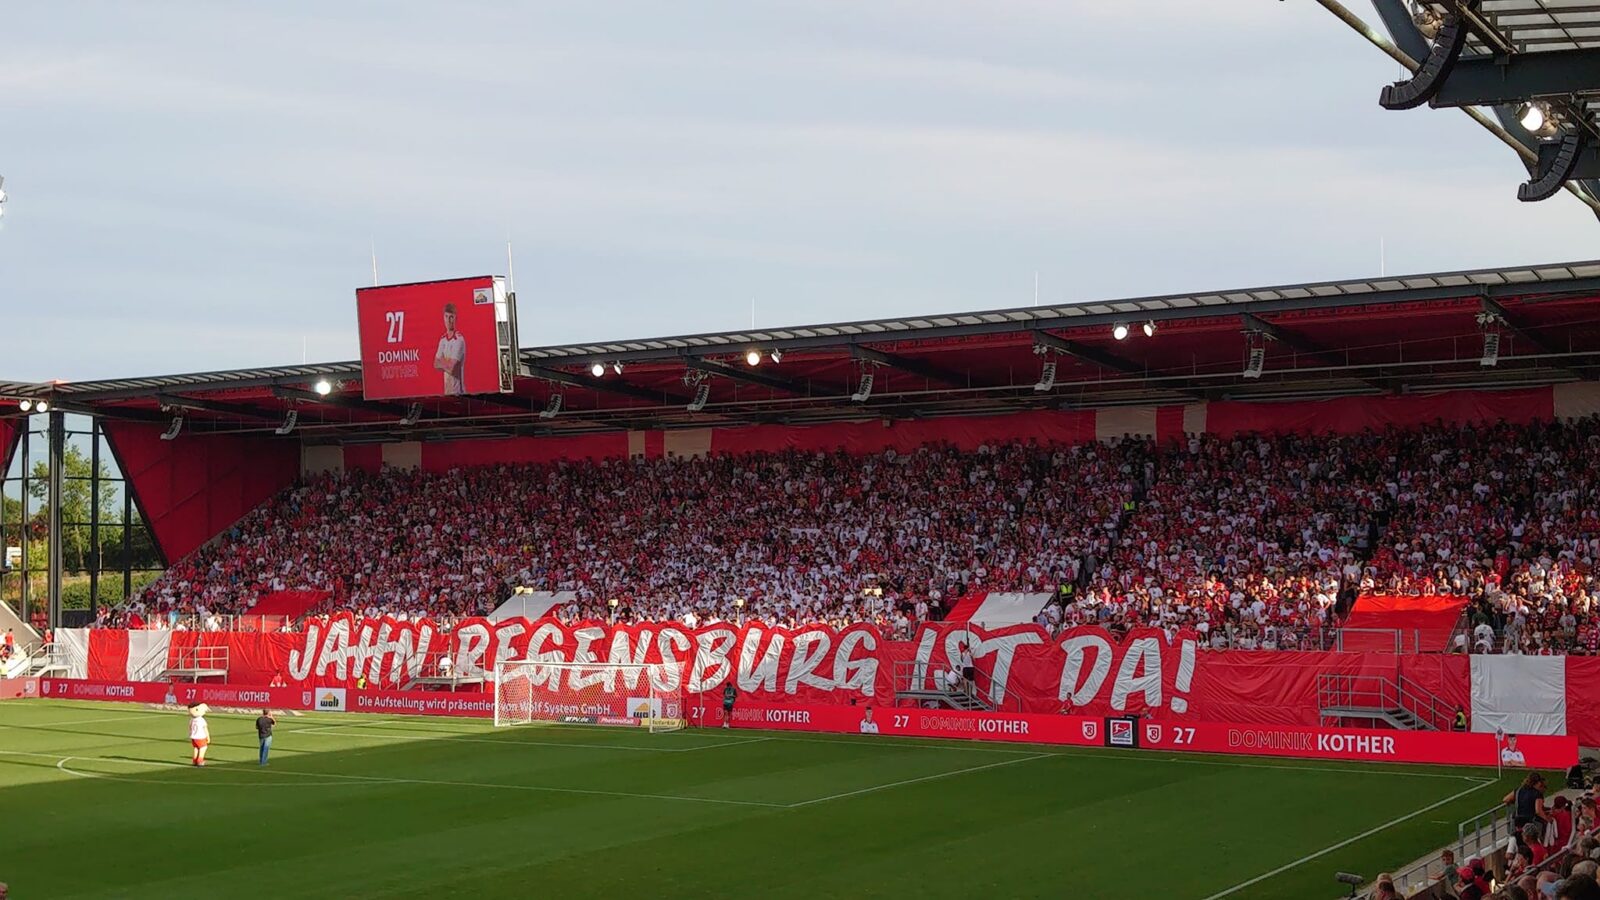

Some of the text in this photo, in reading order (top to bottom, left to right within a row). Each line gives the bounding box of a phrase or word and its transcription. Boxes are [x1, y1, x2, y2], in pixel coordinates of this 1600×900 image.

[385, 312, 405, 343] 27
[378, 349, 420, 364] DOMINIK
[381, 365, 419, 379] KOTHER
[289, 618, 1196, 714] JAHN REGENSBURG IST DA!
[58, 683, 68, 694] 27
[106, 685, 134, 697] KOTHER
[186, 688, 197, 700] 27
[238, 691, 270, 703] KOTHER
[358, 696, 372, 707] Die
[374, 696, 425, 712] Aufstellung
[426, 699, 447, 710] wird
[448, 699, 497, 712] präsentier
[544, 703, 578, 716] System
[581, 703, 611, 715] GmbH
[692, 707, 811, 723] 27 DMINIK KOTHER
[893, 715, 1029, 734] 27 DOMINIK KOTHER
[1173, 727, 1395, 755] 27 DOMINIK KOTHER
